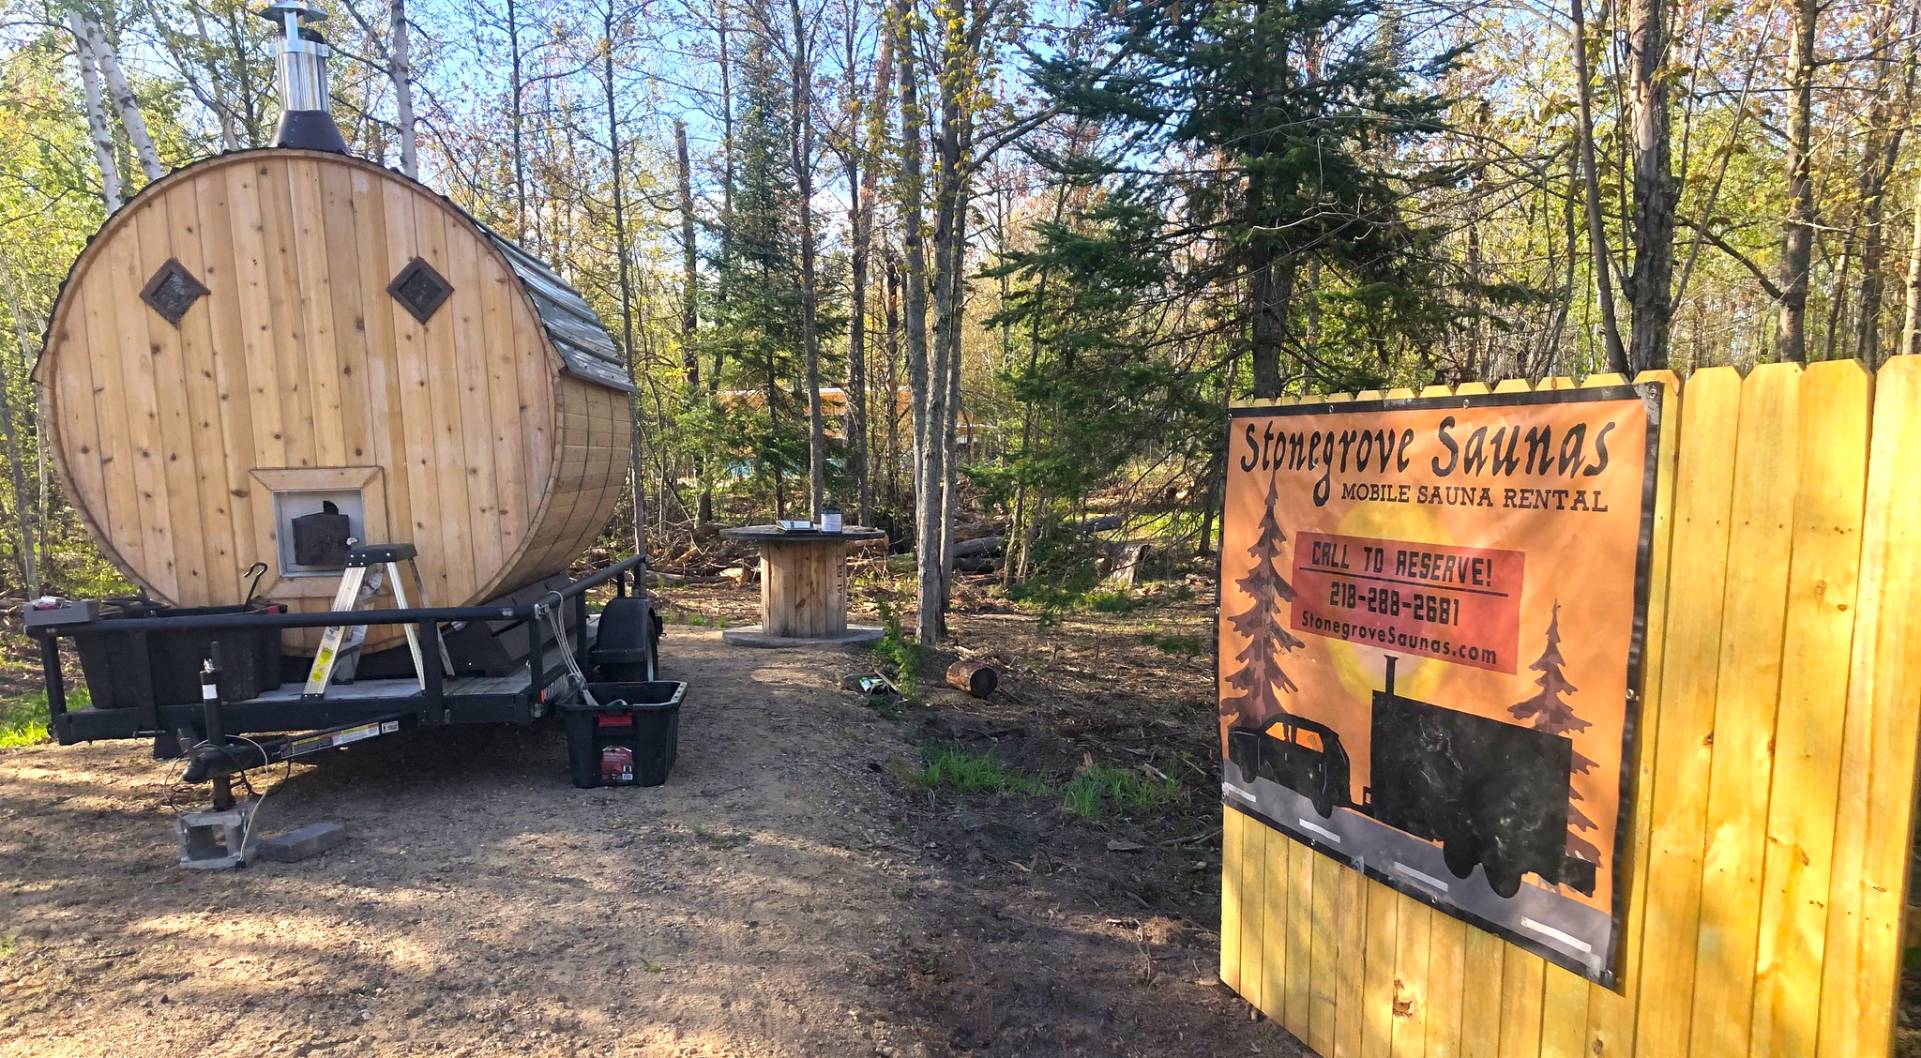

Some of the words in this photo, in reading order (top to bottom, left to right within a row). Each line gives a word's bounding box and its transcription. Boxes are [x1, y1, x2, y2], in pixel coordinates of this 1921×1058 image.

[1240, 420, 1415, 507] Stonegrove
[1431, 415, 1616, 478] Saunas
[1341, 483, 1411, 503] MOBILE
[1417, 485, 1494, 507] SAUNA
[1503, 489, 1609, 512] RENTAL
[1312, 541, 1350, 569] CALL
[1363, 546, 1385, 573] TO
[1398, 550, 1493, 586] RESERVE!
[1329, 581, 1460, 626] 218-288-2681
[1301, 610, 1497, 664] StonegroveSaunas.com
